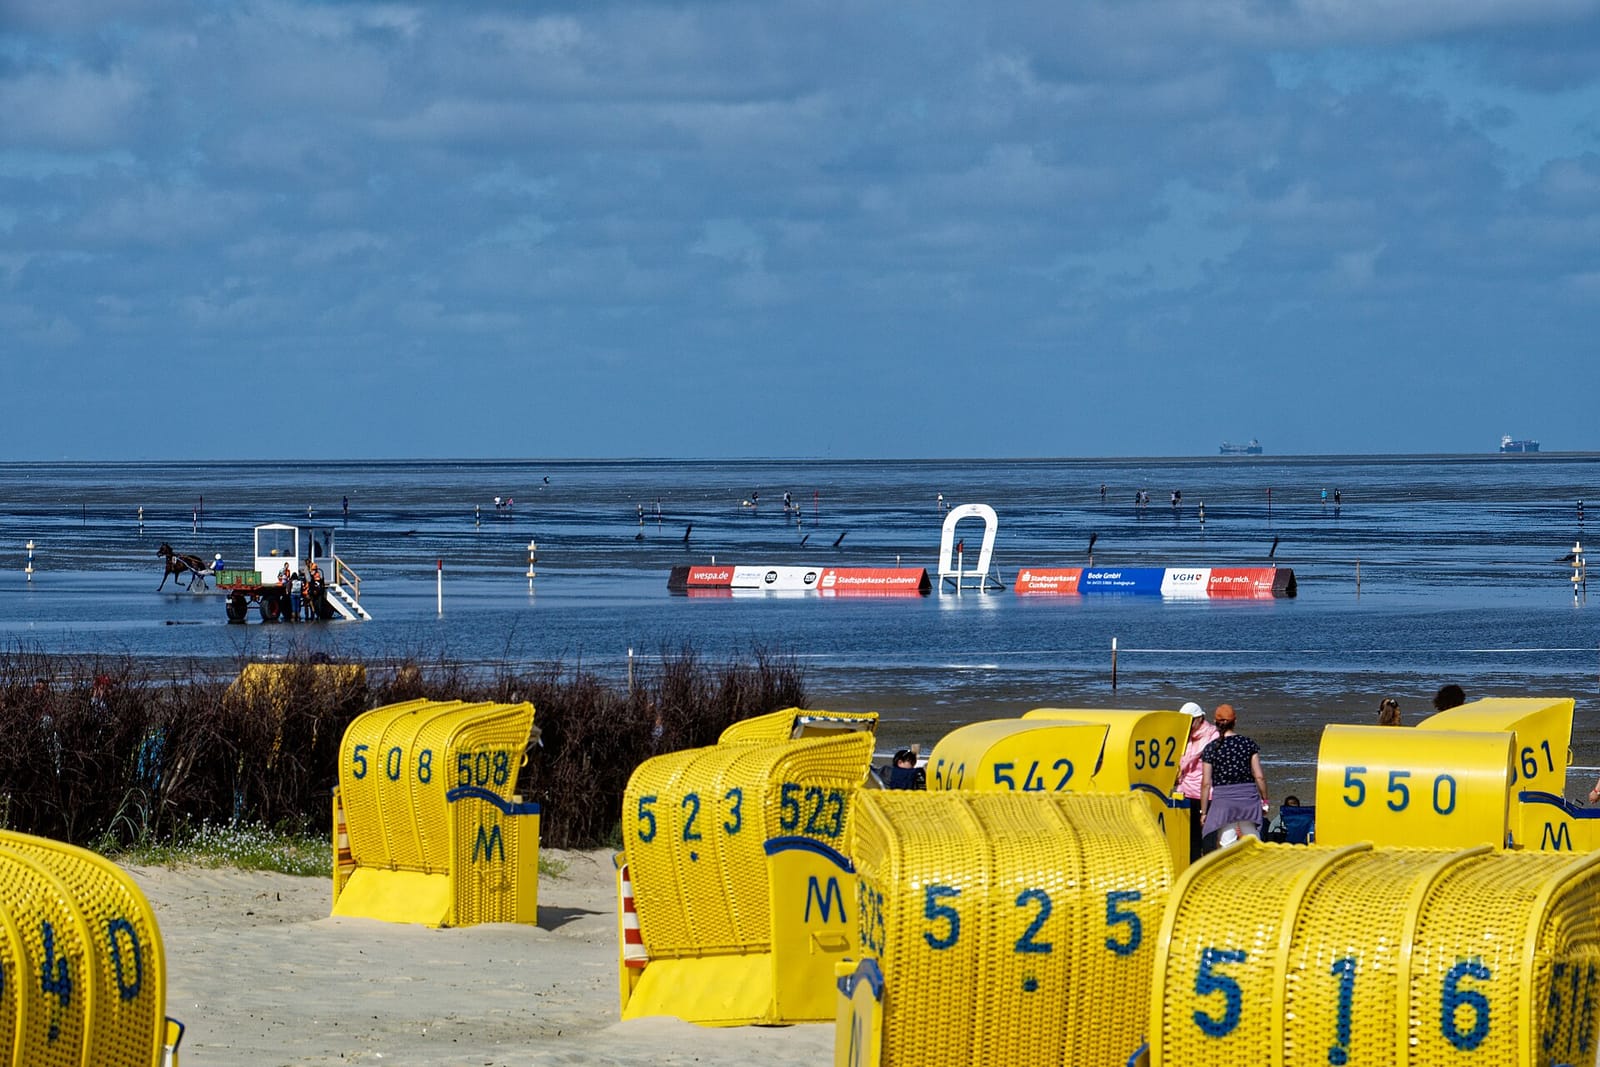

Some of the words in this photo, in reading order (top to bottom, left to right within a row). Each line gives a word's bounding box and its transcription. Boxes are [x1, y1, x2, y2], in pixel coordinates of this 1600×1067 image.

[693, 571, 729, 581] wespa.de
[838, 576, 885, 585] Stadtsparkasse
[1172, 573, 1194, 581] VGH
[352, 744, 432, 784] 508
[458, 750, 509, 787] 508
[1134, 736, 1176, 770] 582
[994, 758, 1074, 792] 542
[1343, 766, 1456, 815] 550
[638, 787, 742, 843] 523
[780, 782, 844, 839] 523
[804, 876, 847, 924] M
